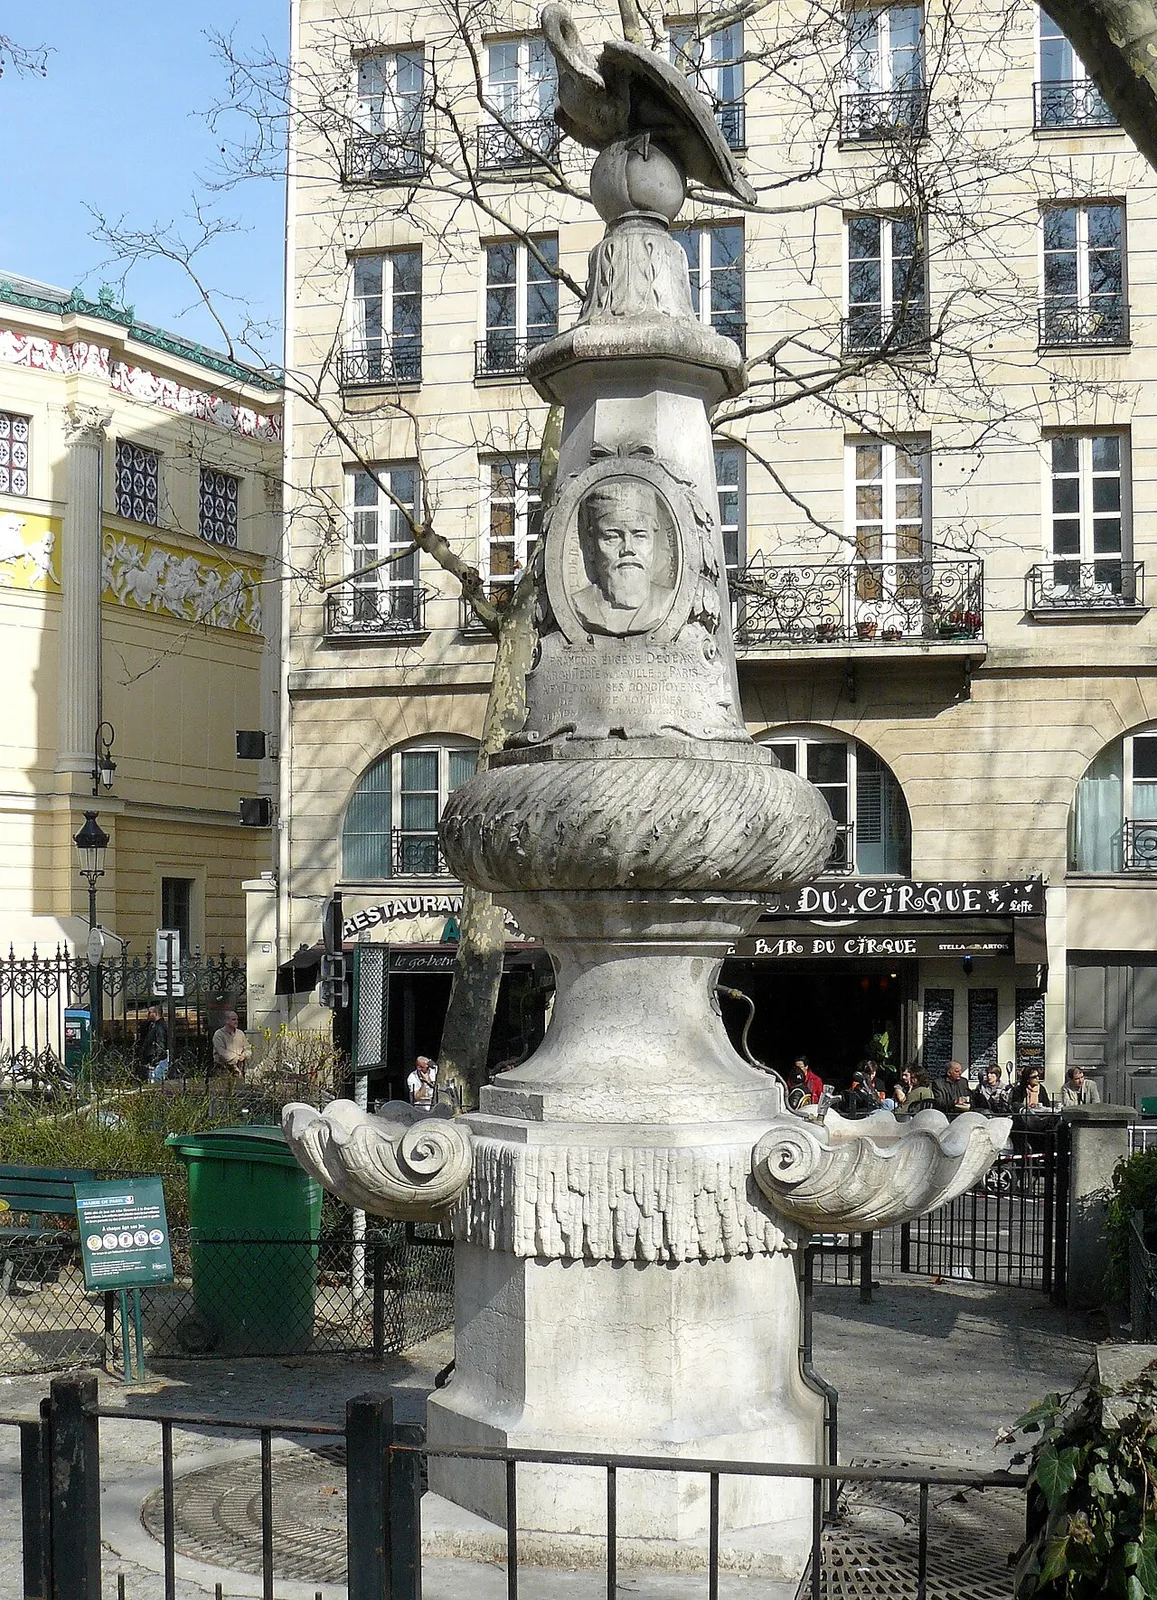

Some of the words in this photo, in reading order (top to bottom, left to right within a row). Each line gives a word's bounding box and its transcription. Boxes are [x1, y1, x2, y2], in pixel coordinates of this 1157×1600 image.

[626, 668, 654, 678] VILLE
[669, 665, 699, 678] PARIS
[605, 682, 625, 693] SES
[795, 886, 837, 914] DU
[343, 896, 464, 937] RESTAURAN
[755, 938, 804, 956] BAR
[811, 939, 836, 954] DU
[983, 943, 1009, 951] ARTOIS
